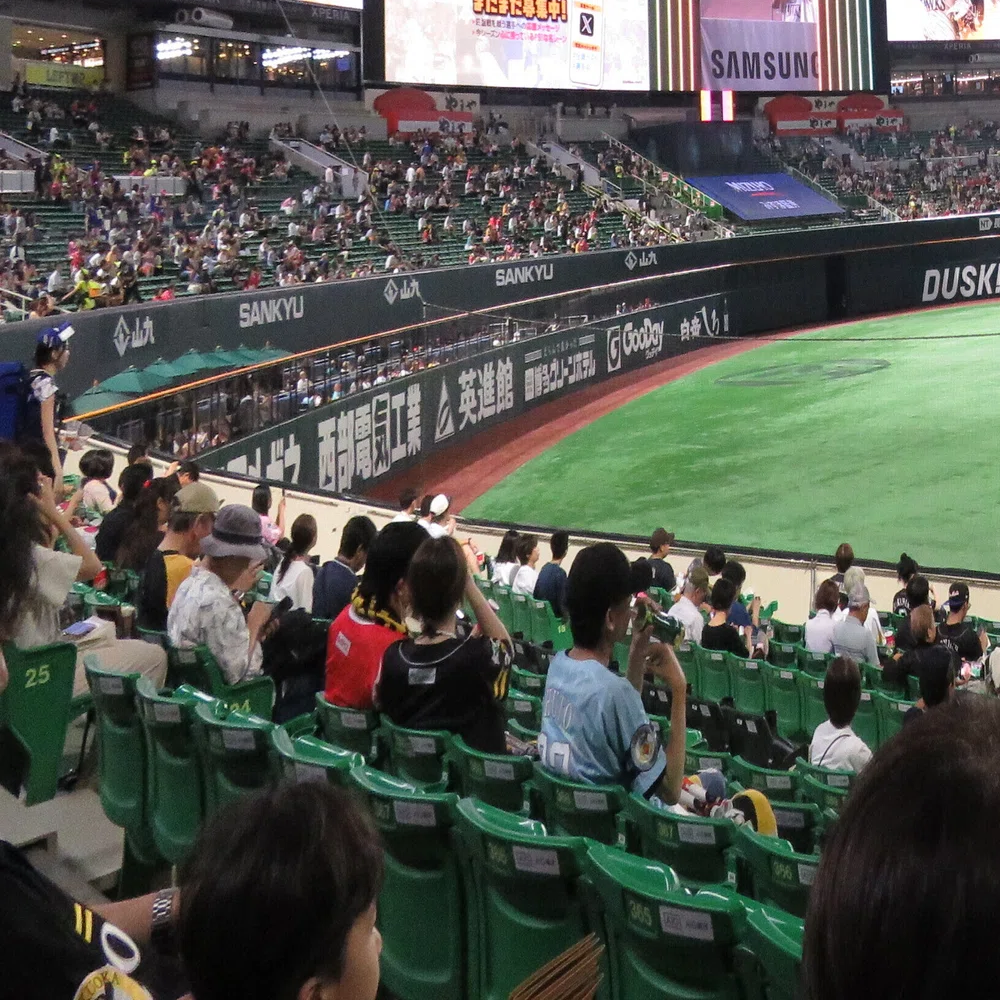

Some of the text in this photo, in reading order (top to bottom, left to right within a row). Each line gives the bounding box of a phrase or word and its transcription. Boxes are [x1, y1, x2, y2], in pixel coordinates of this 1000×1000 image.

[312, 6, 350, 21] XPERIA
[495, 263, 554, 287] SANKYU
[639, 251, 658, 268] 山九
[399, 278, 421, 300] 山九
[239, 296, 304, 329] SANKYU
[131, 315, 155, 348] 山九
[623, 317, 664, 356] GooDay
[535, 349, 596, 398] 博多グリーンホテル
[458, 356, 514, 431] 英進館
[318, 383, 422, 493] 西部電気工業
[25, 664, 50, 689] 25
